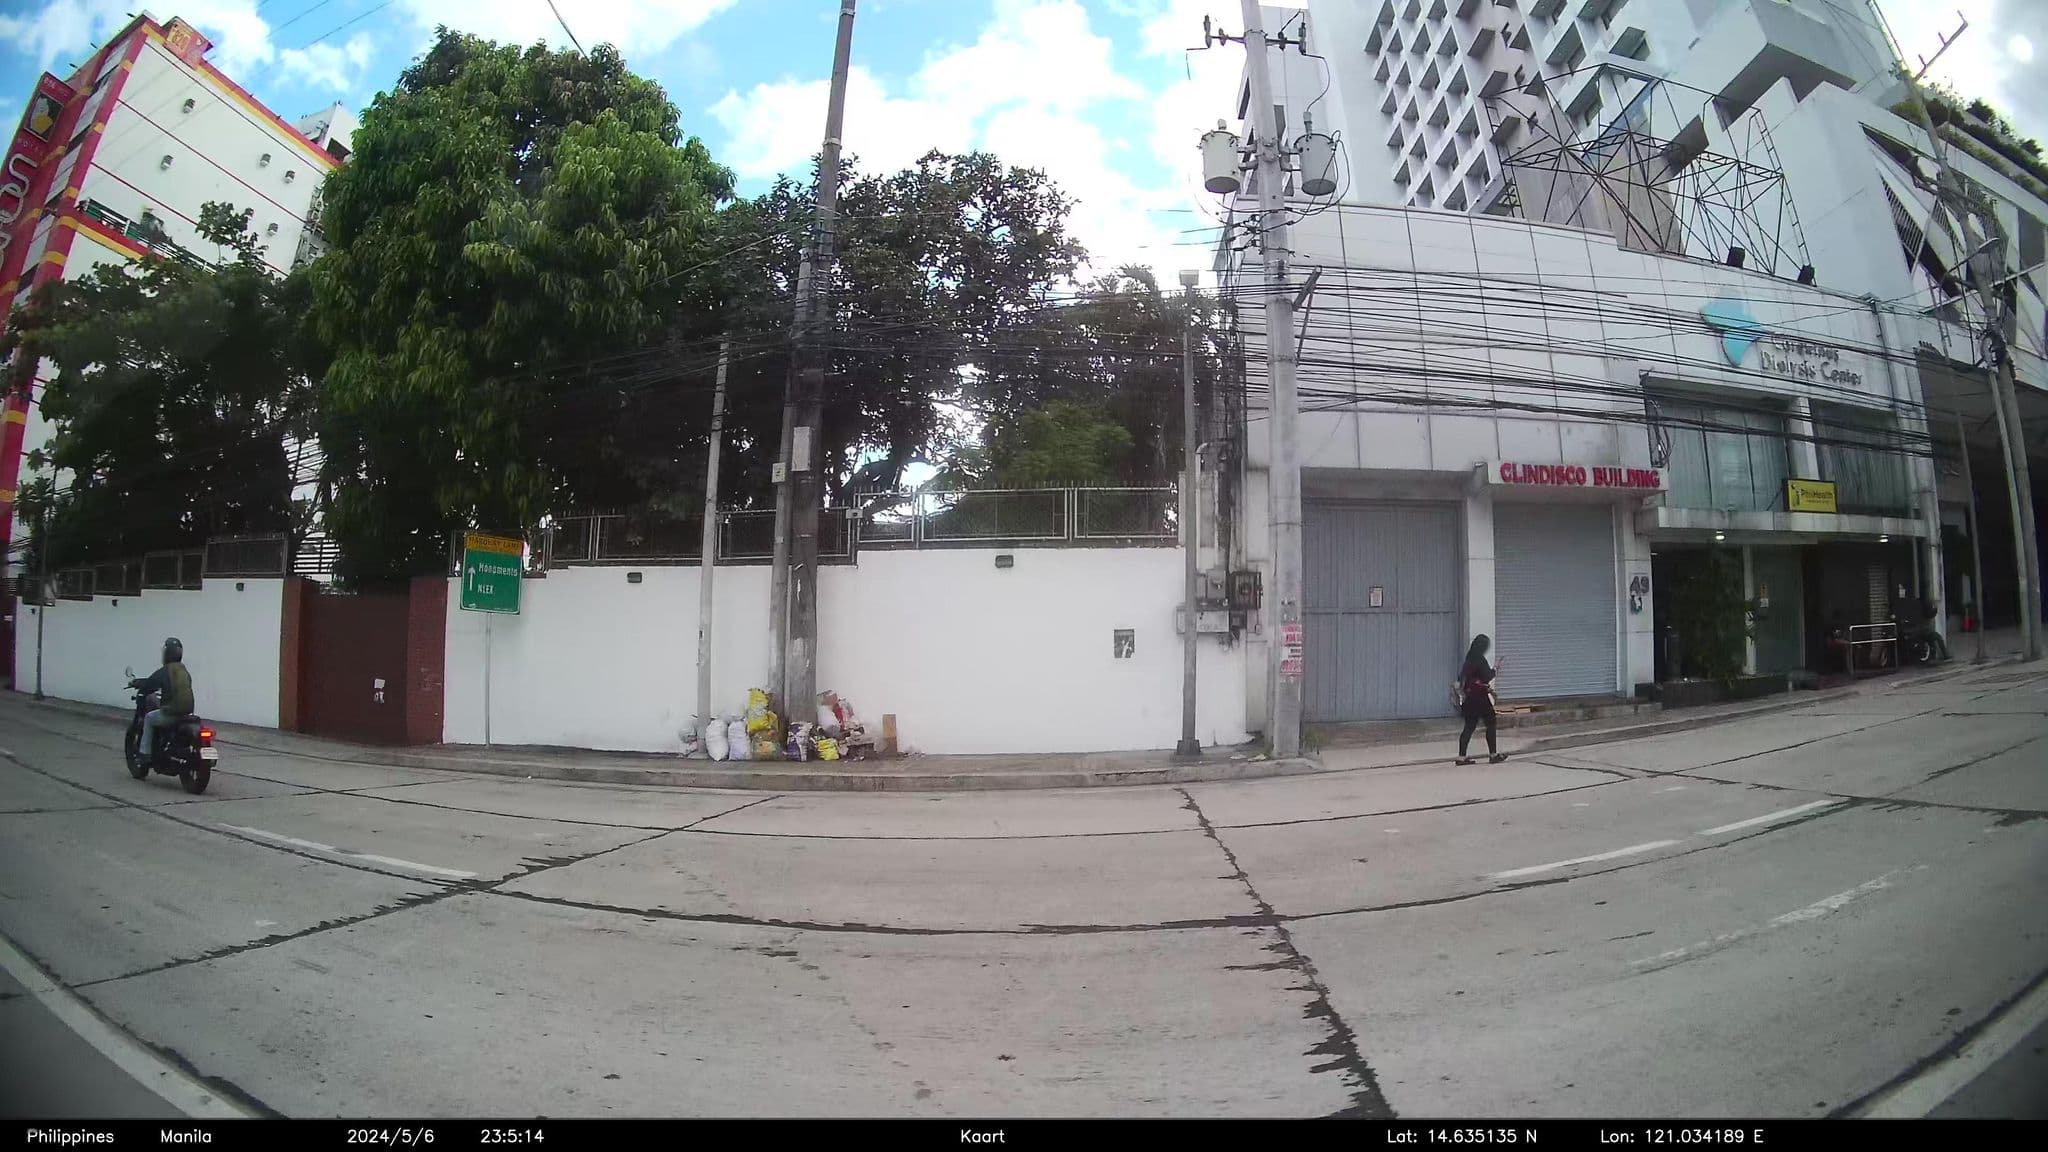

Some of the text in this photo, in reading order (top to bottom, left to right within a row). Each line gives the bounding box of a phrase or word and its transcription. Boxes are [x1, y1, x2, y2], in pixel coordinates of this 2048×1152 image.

[1820, 360, 1862, 386] Center
[1500, 462, 1661, 489] CLINDISCO BUILDING
